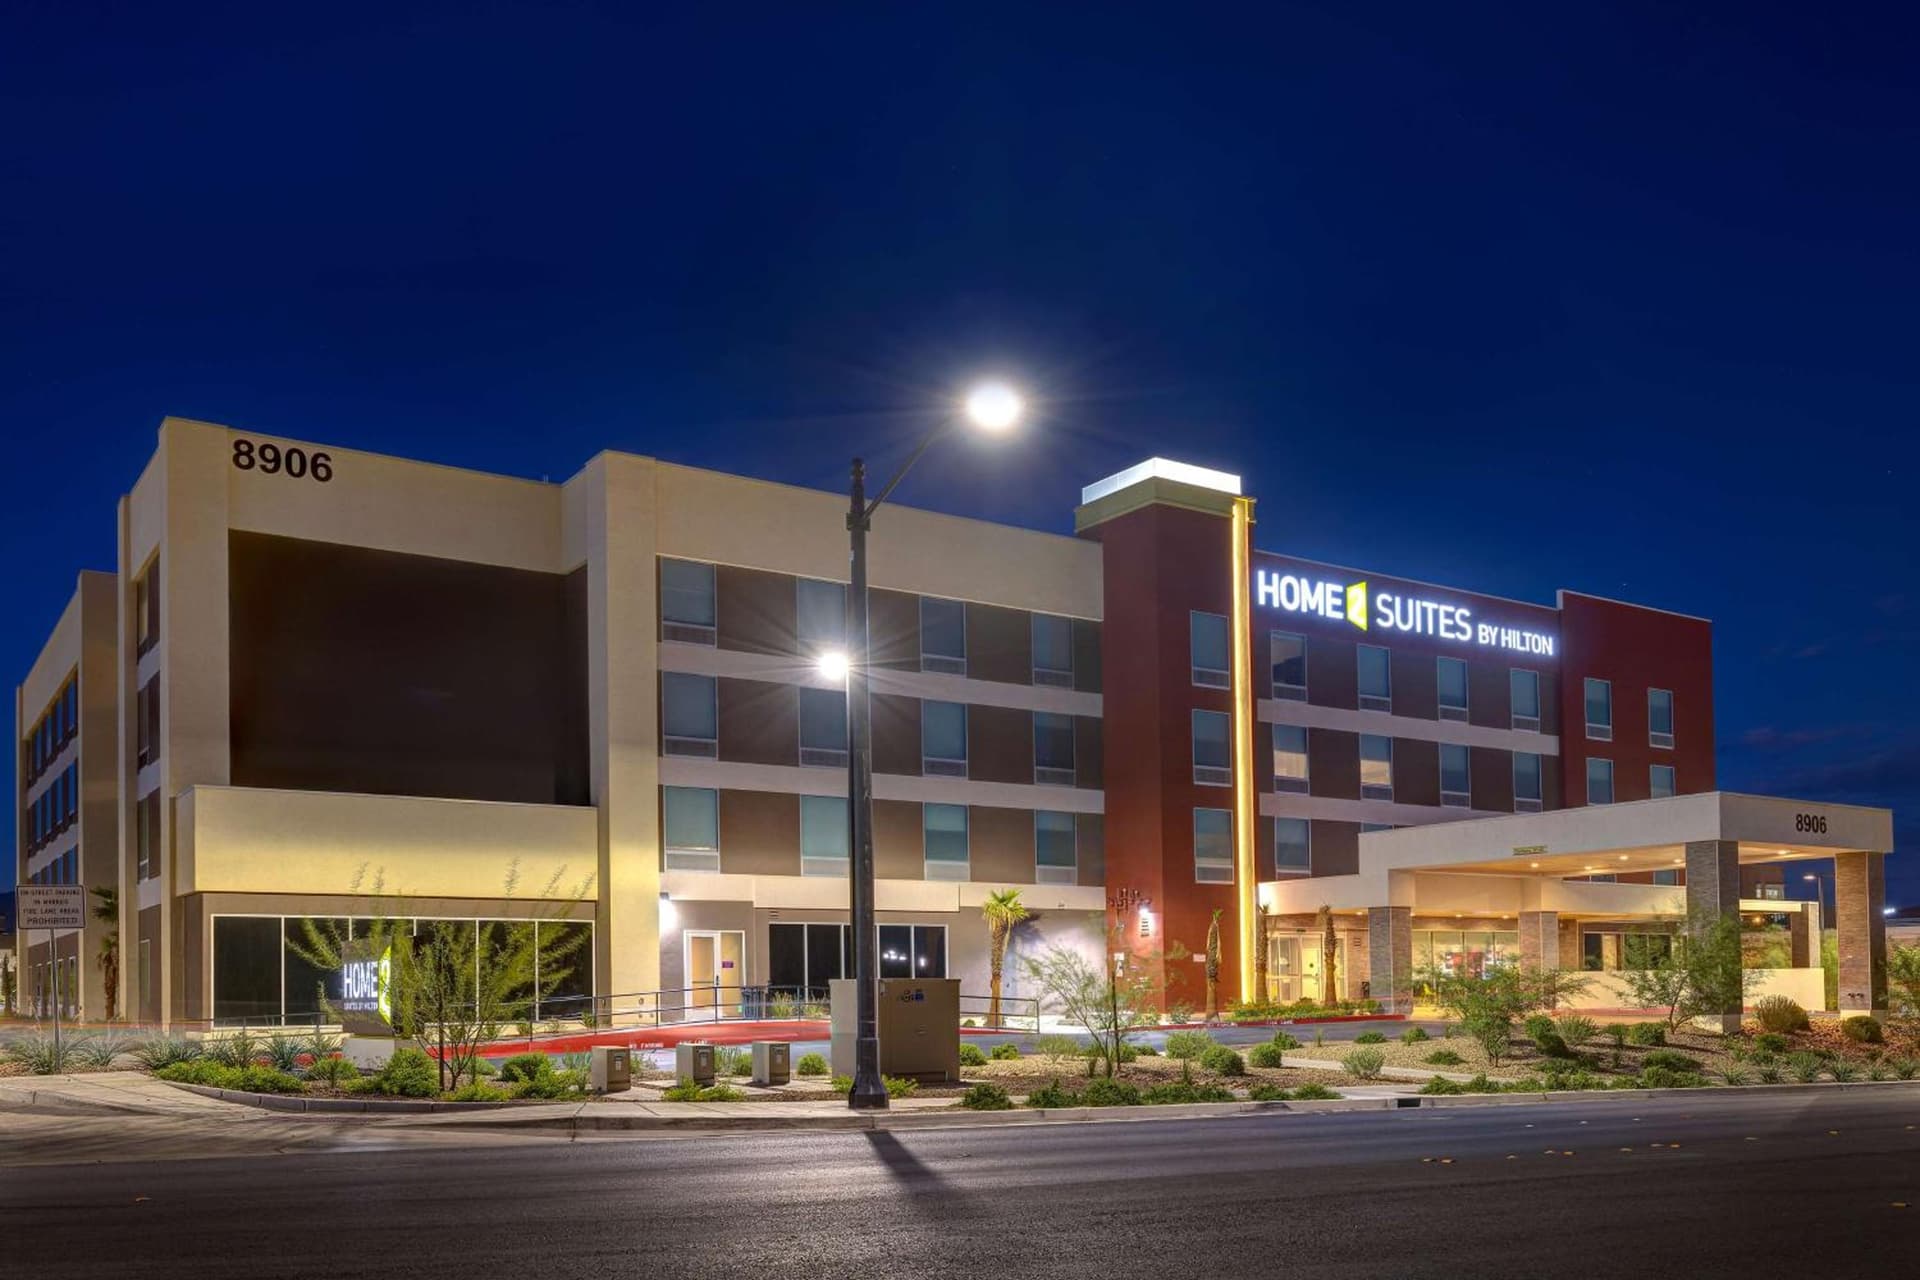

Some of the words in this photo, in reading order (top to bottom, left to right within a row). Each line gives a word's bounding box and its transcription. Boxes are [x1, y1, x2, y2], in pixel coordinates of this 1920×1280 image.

[232, 439, 333, 482] 8906
[1376, 593, 1473, 641] SUITES
[1478, 624, 1498, 646] BY
[1501, 628, 1553, 655] HILTON
[1795, 813, 1827, 834] 8906
[27, 917, 78, 925] PROHIBITED
